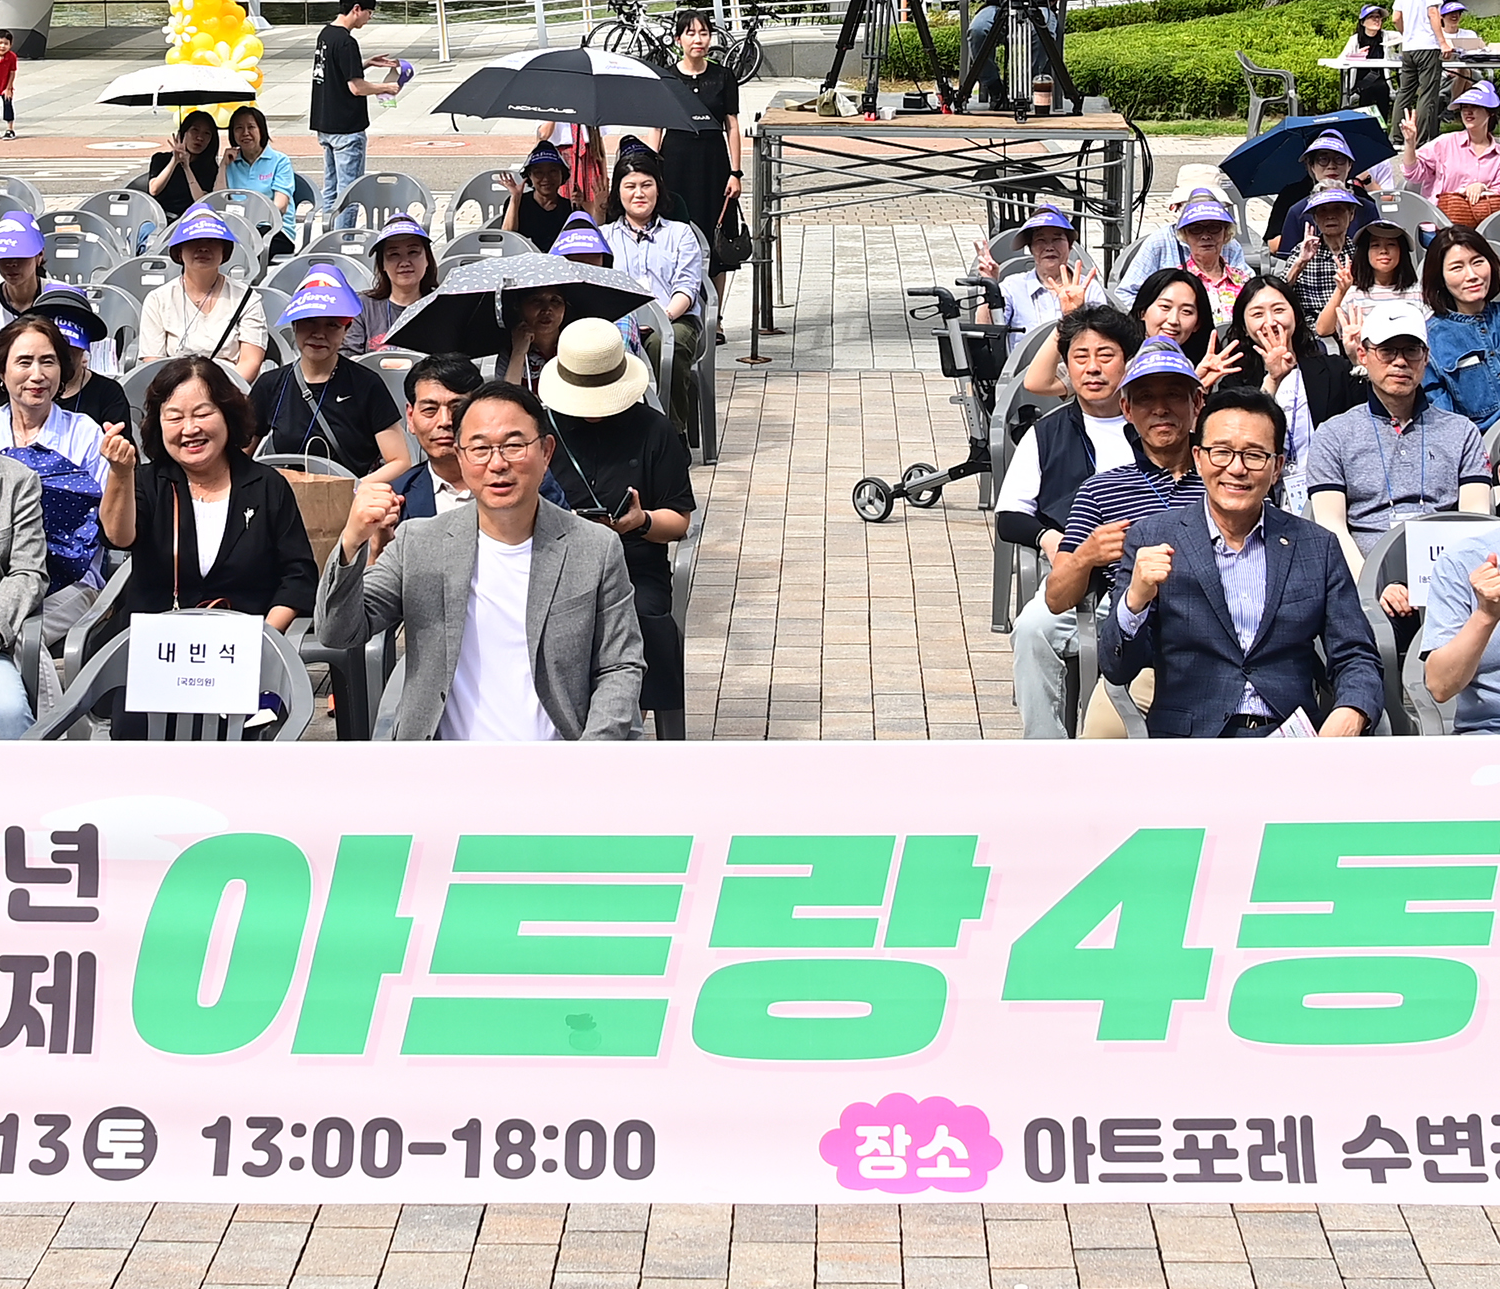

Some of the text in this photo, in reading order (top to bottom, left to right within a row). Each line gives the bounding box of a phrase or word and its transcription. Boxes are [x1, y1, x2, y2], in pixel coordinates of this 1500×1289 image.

[177, 677, 215, 687] [국회의원]
[129, 831, 993, 1061] 아트랑
[204, 1113, 657, 1183] 13:00-18:00
[856, 1121, 970, 1179] 장소
[1024, 1115, 1317, 1185] 아트포레
